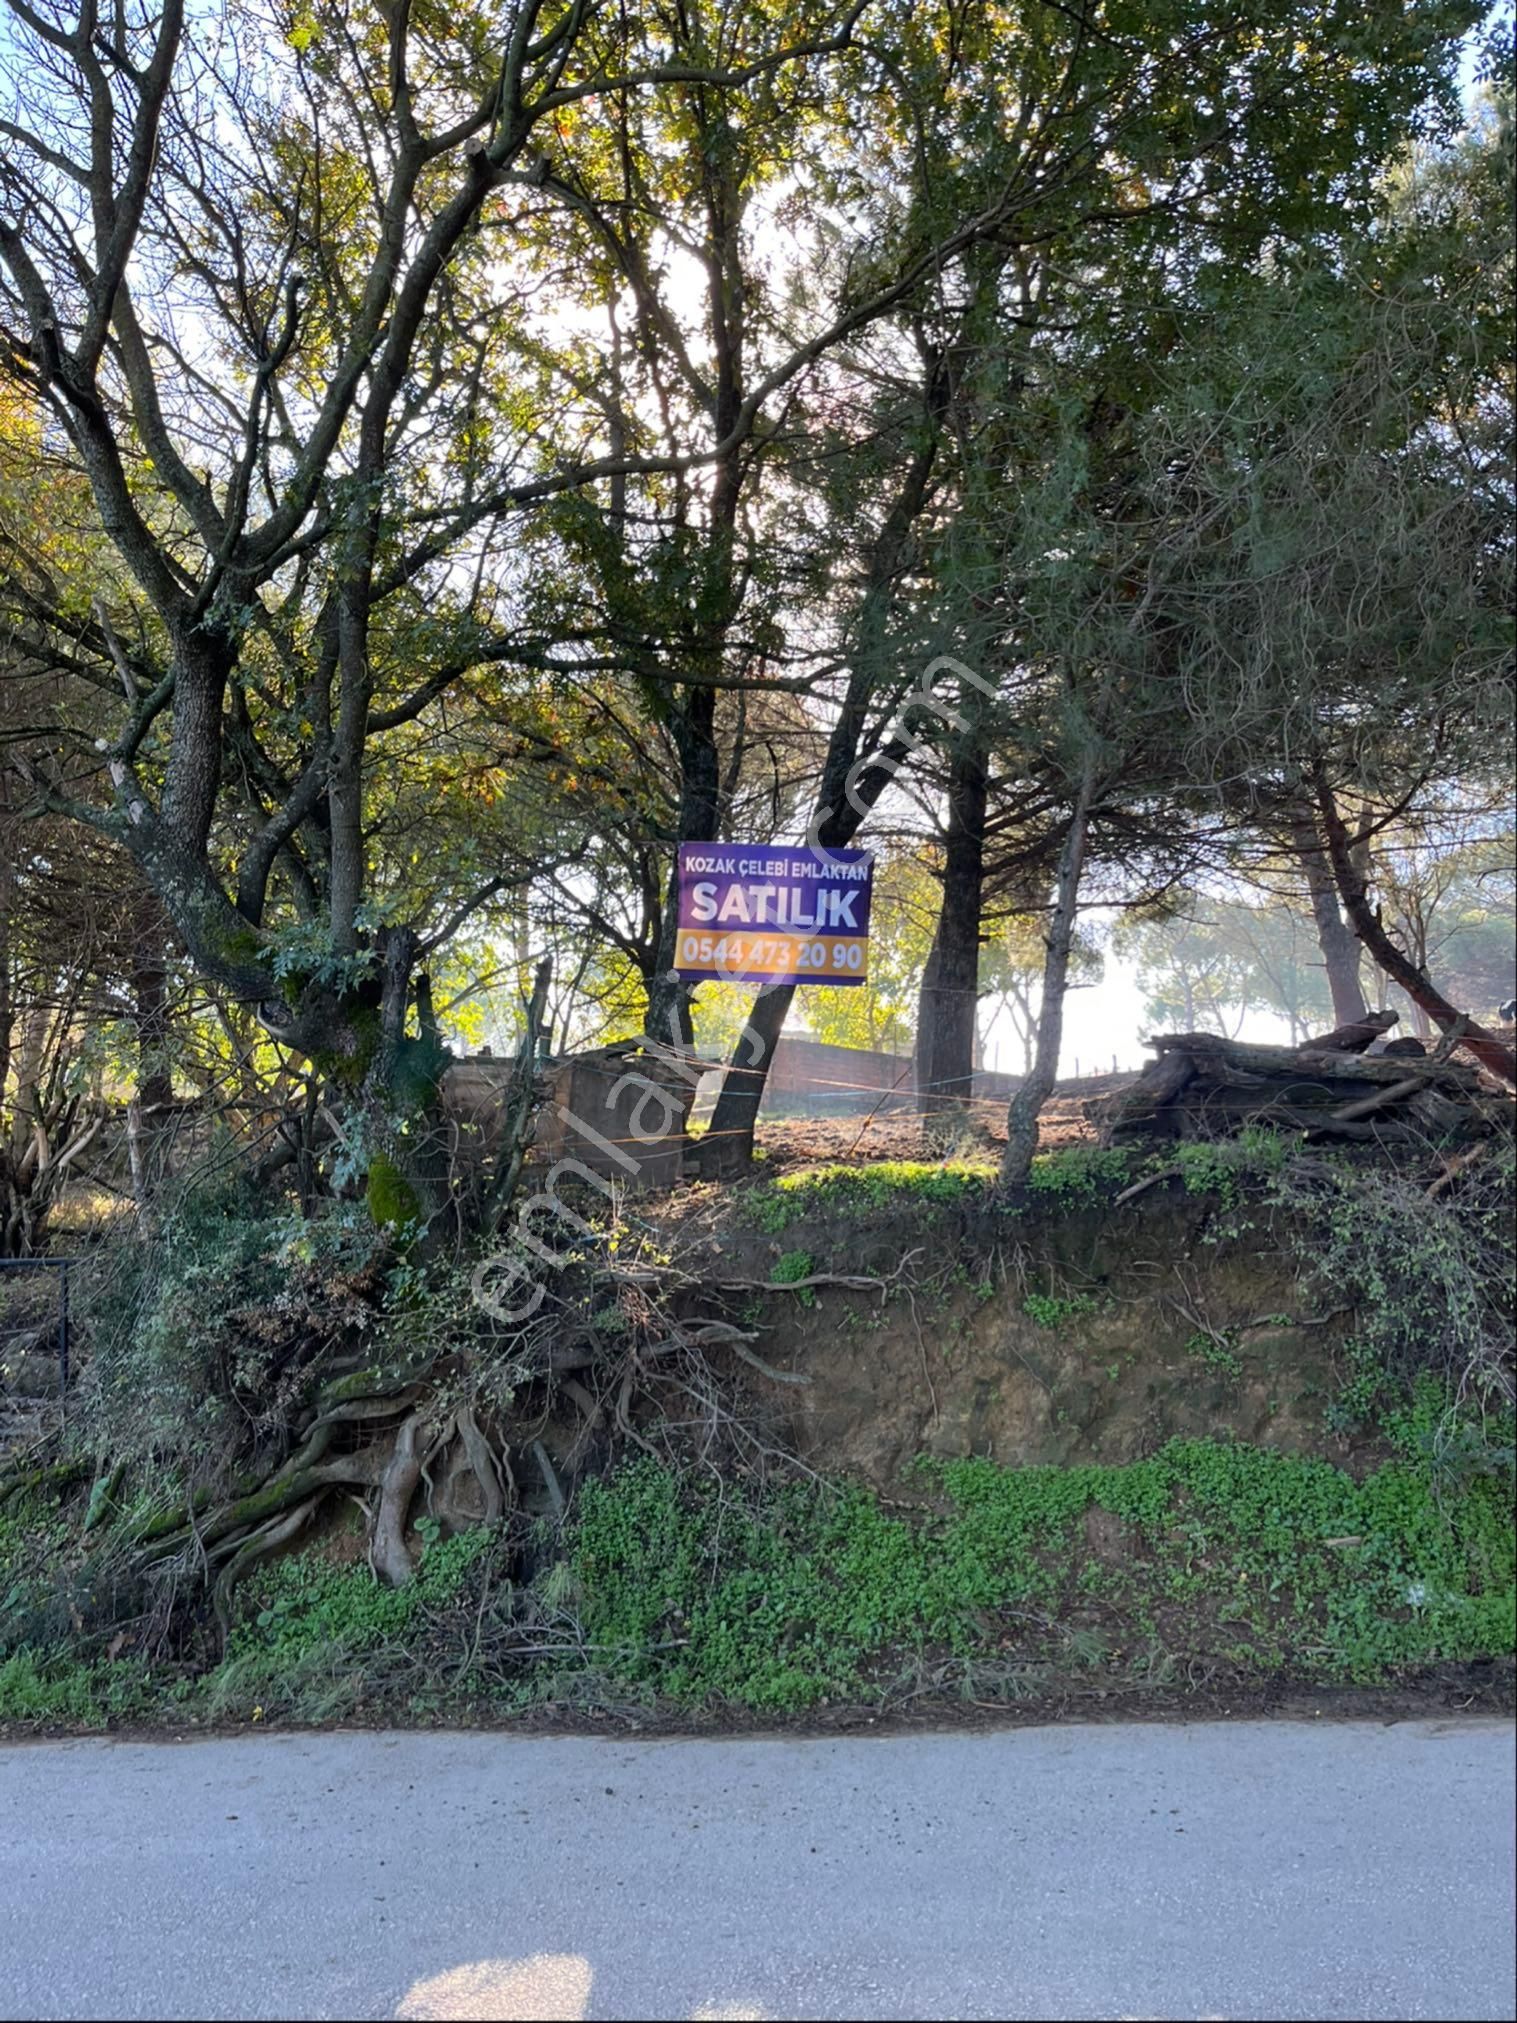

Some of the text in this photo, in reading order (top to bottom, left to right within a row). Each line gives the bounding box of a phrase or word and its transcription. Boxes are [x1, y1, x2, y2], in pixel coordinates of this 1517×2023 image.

[686, 856, 868, 881] KOZAK ÇELEBİ EMLAKTAN
[690, 881, 861, 929] SATILIK
[683, 937, 862, 970] 0544 473 20 90
